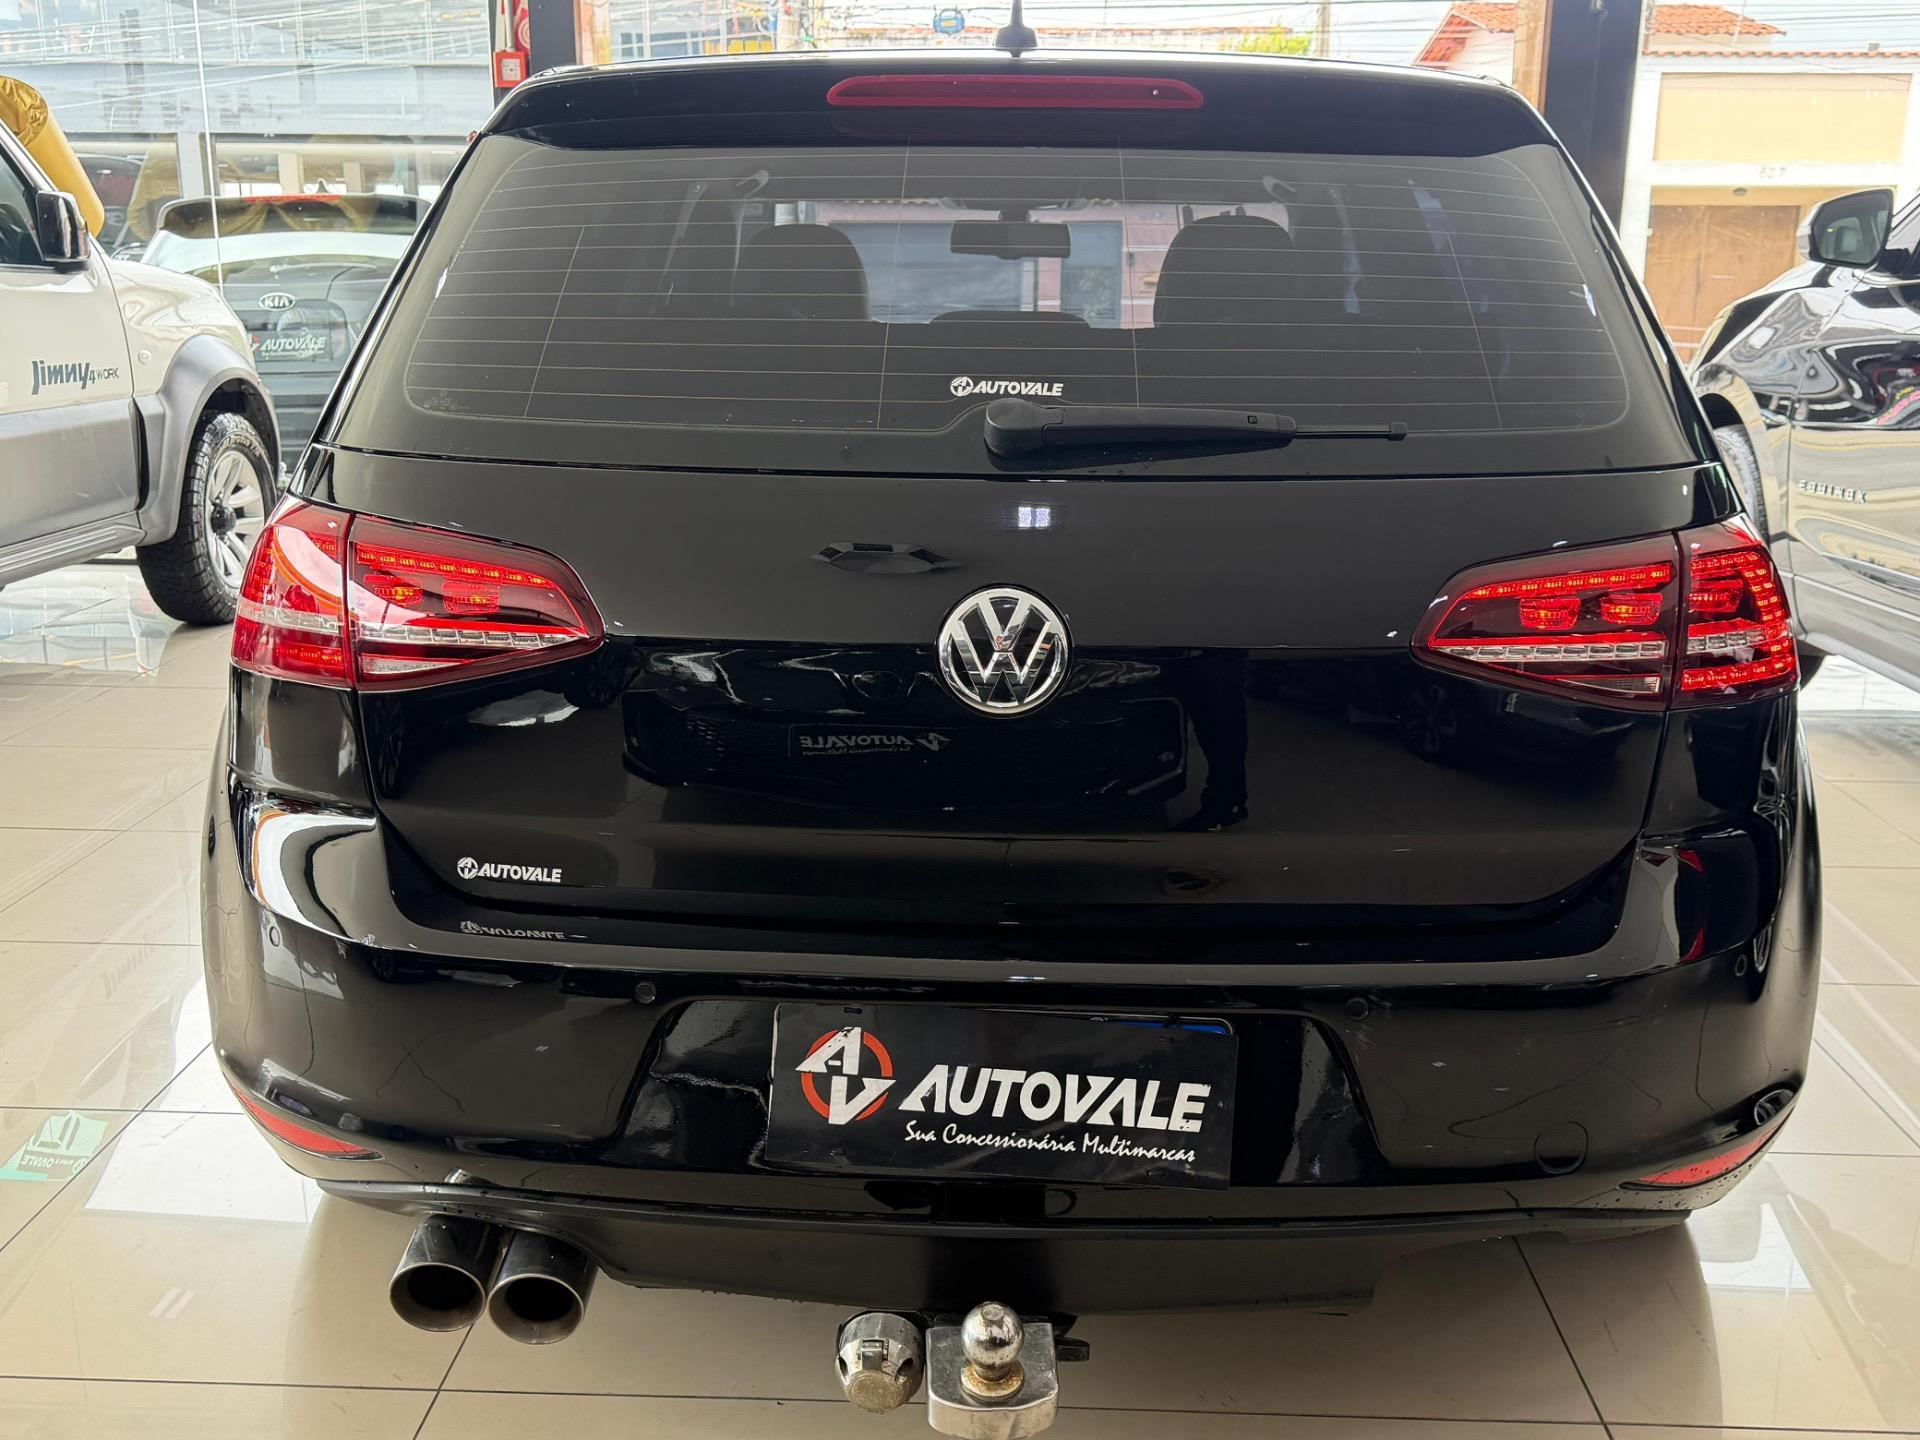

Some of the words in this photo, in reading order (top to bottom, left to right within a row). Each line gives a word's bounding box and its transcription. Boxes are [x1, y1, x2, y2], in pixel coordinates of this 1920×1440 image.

[264, 296, 290, 308] KIA
[261, 336, 327, 351] AUTOVALE
[31, 360, 90, 395] Jimny
[972, 381, 1064, 396] AUTOVALE
[478, 863, 562, 883] AUTOVALE
[898, 1064, 1211, 1133] AUTOVALE
[904, 1120, 936, 1142] Sua
[942, 1123, 1076, 1152] Concessionária
[1081, 1133, 1196, 1162] Multimarcas
